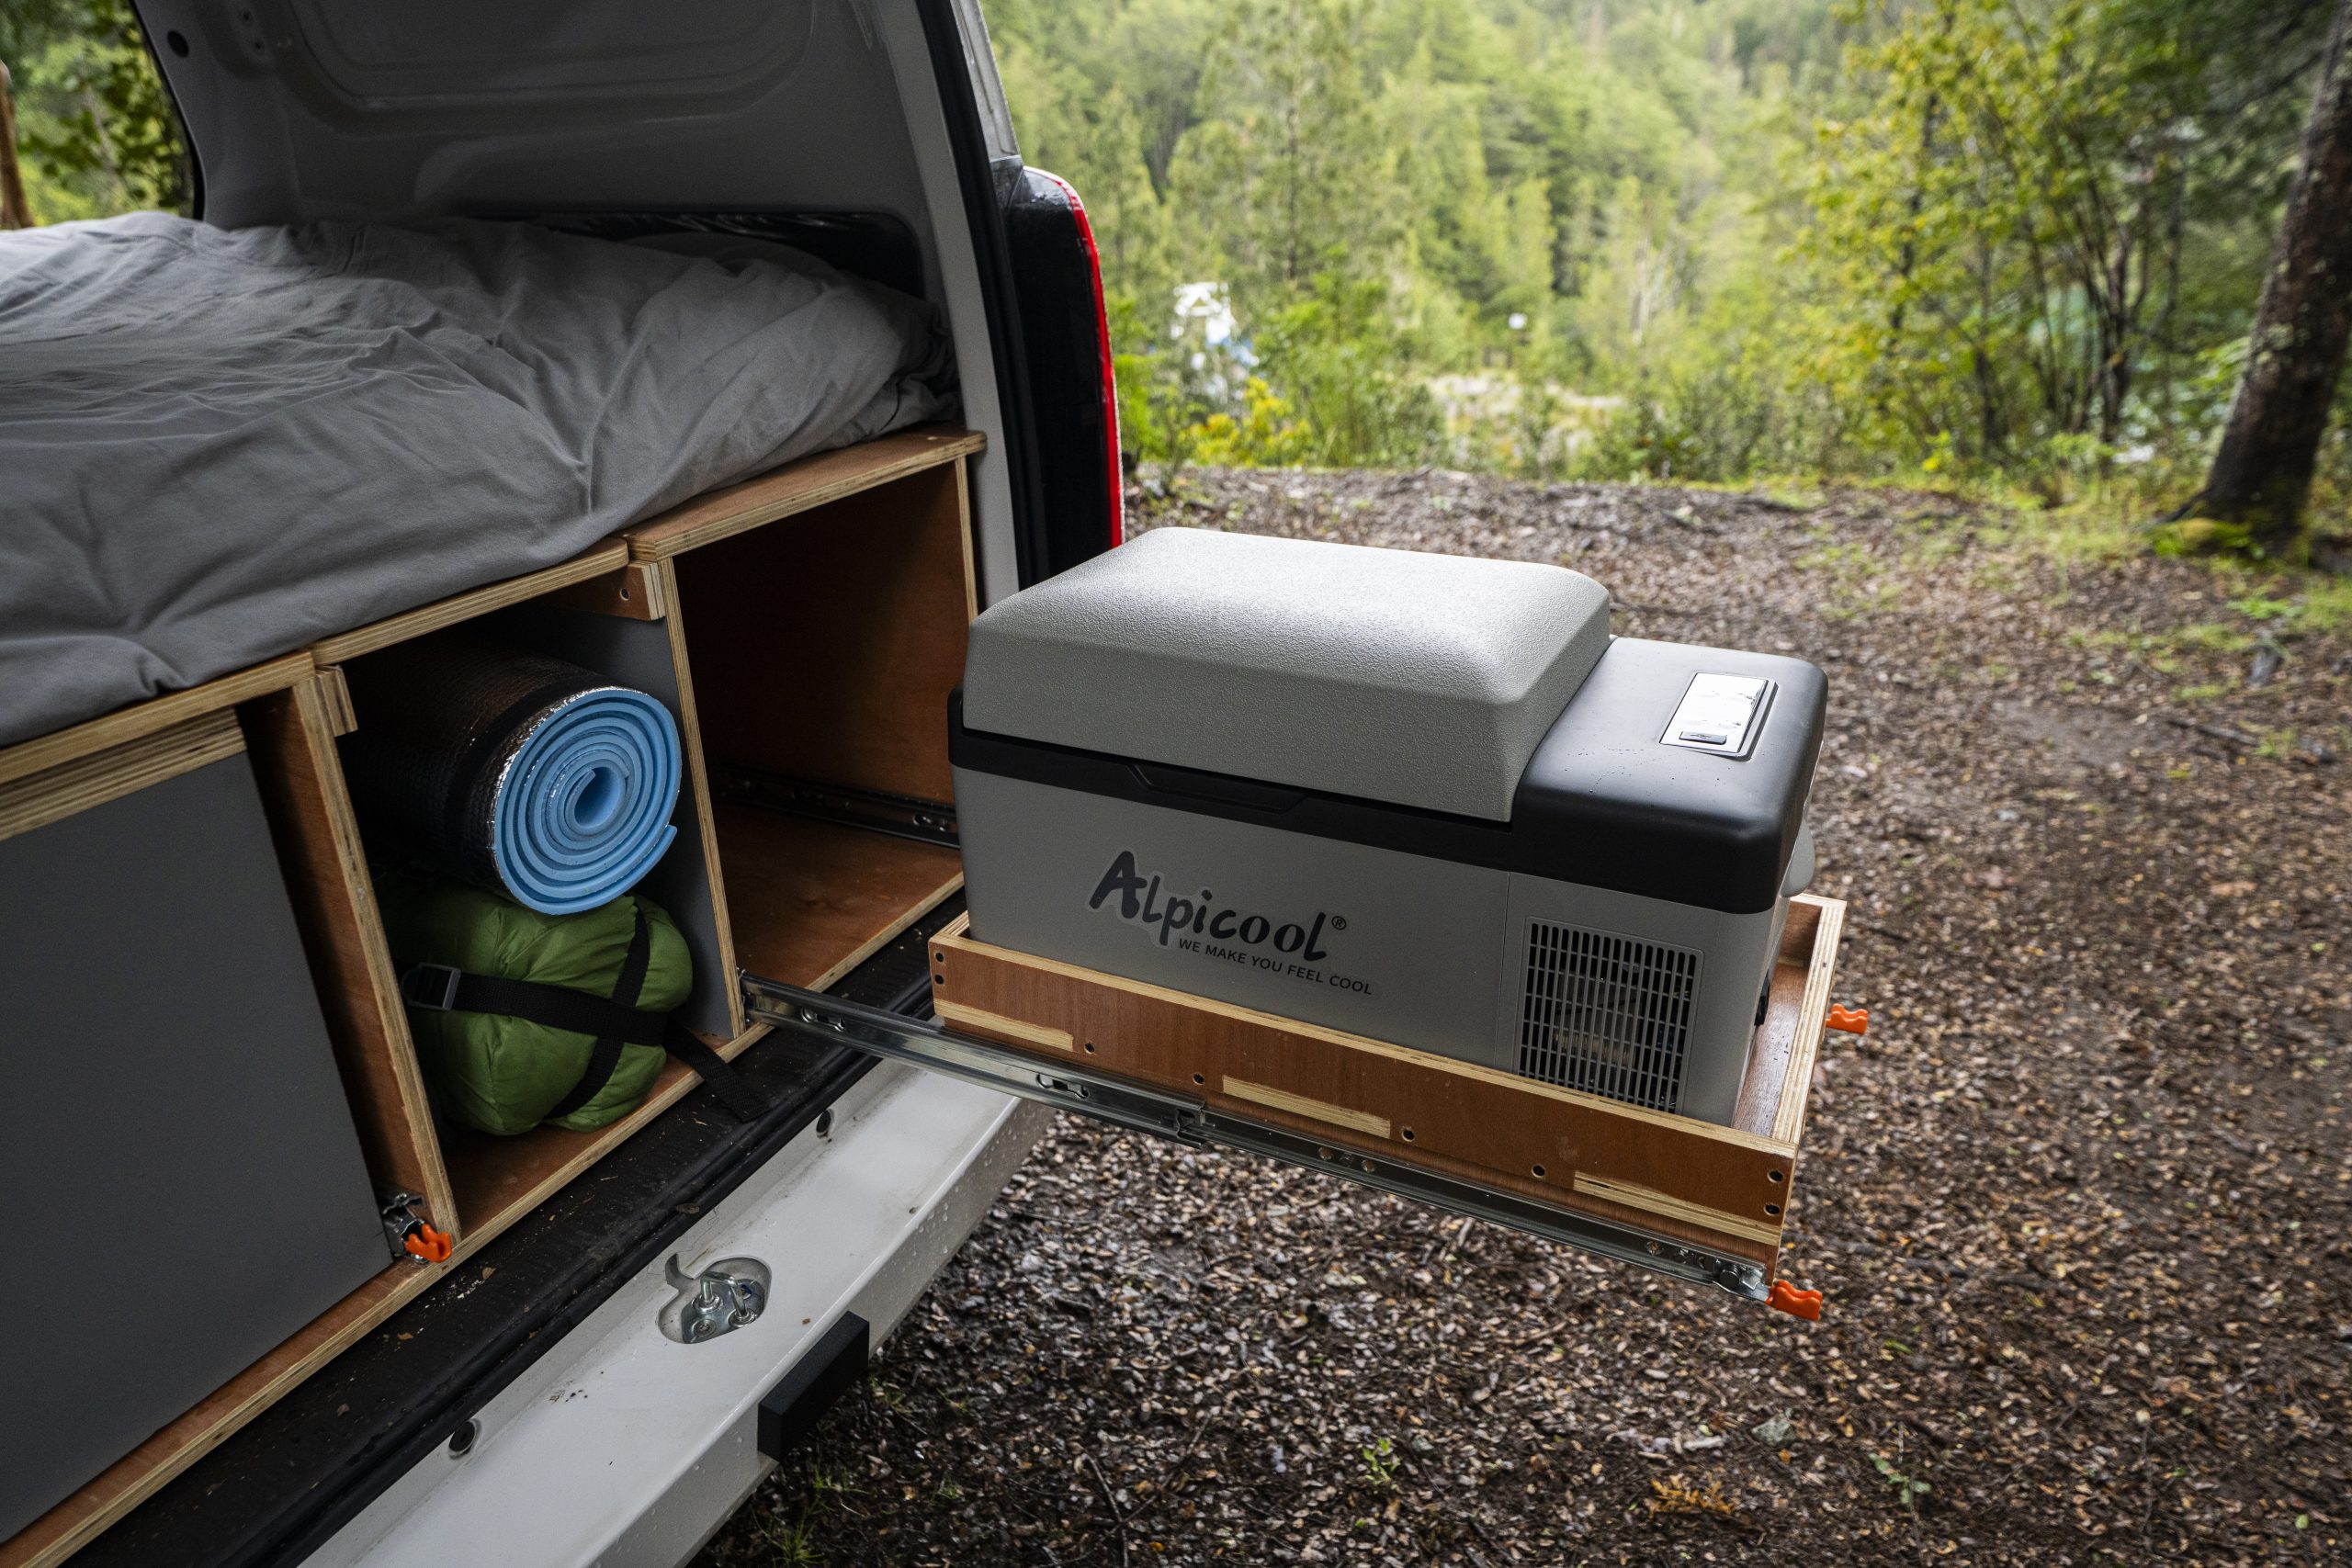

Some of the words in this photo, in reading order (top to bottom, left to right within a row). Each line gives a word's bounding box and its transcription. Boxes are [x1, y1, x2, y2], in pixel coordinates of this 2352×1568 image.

[1179, 938, 1201, 953] WE
[1204, 945, 1246, 964] MAKE
[1251, 955, 1283, 972] YOU
[1287, 964, 1324, 983] FEEL
[1329, 975, 1373, 995] COOL
